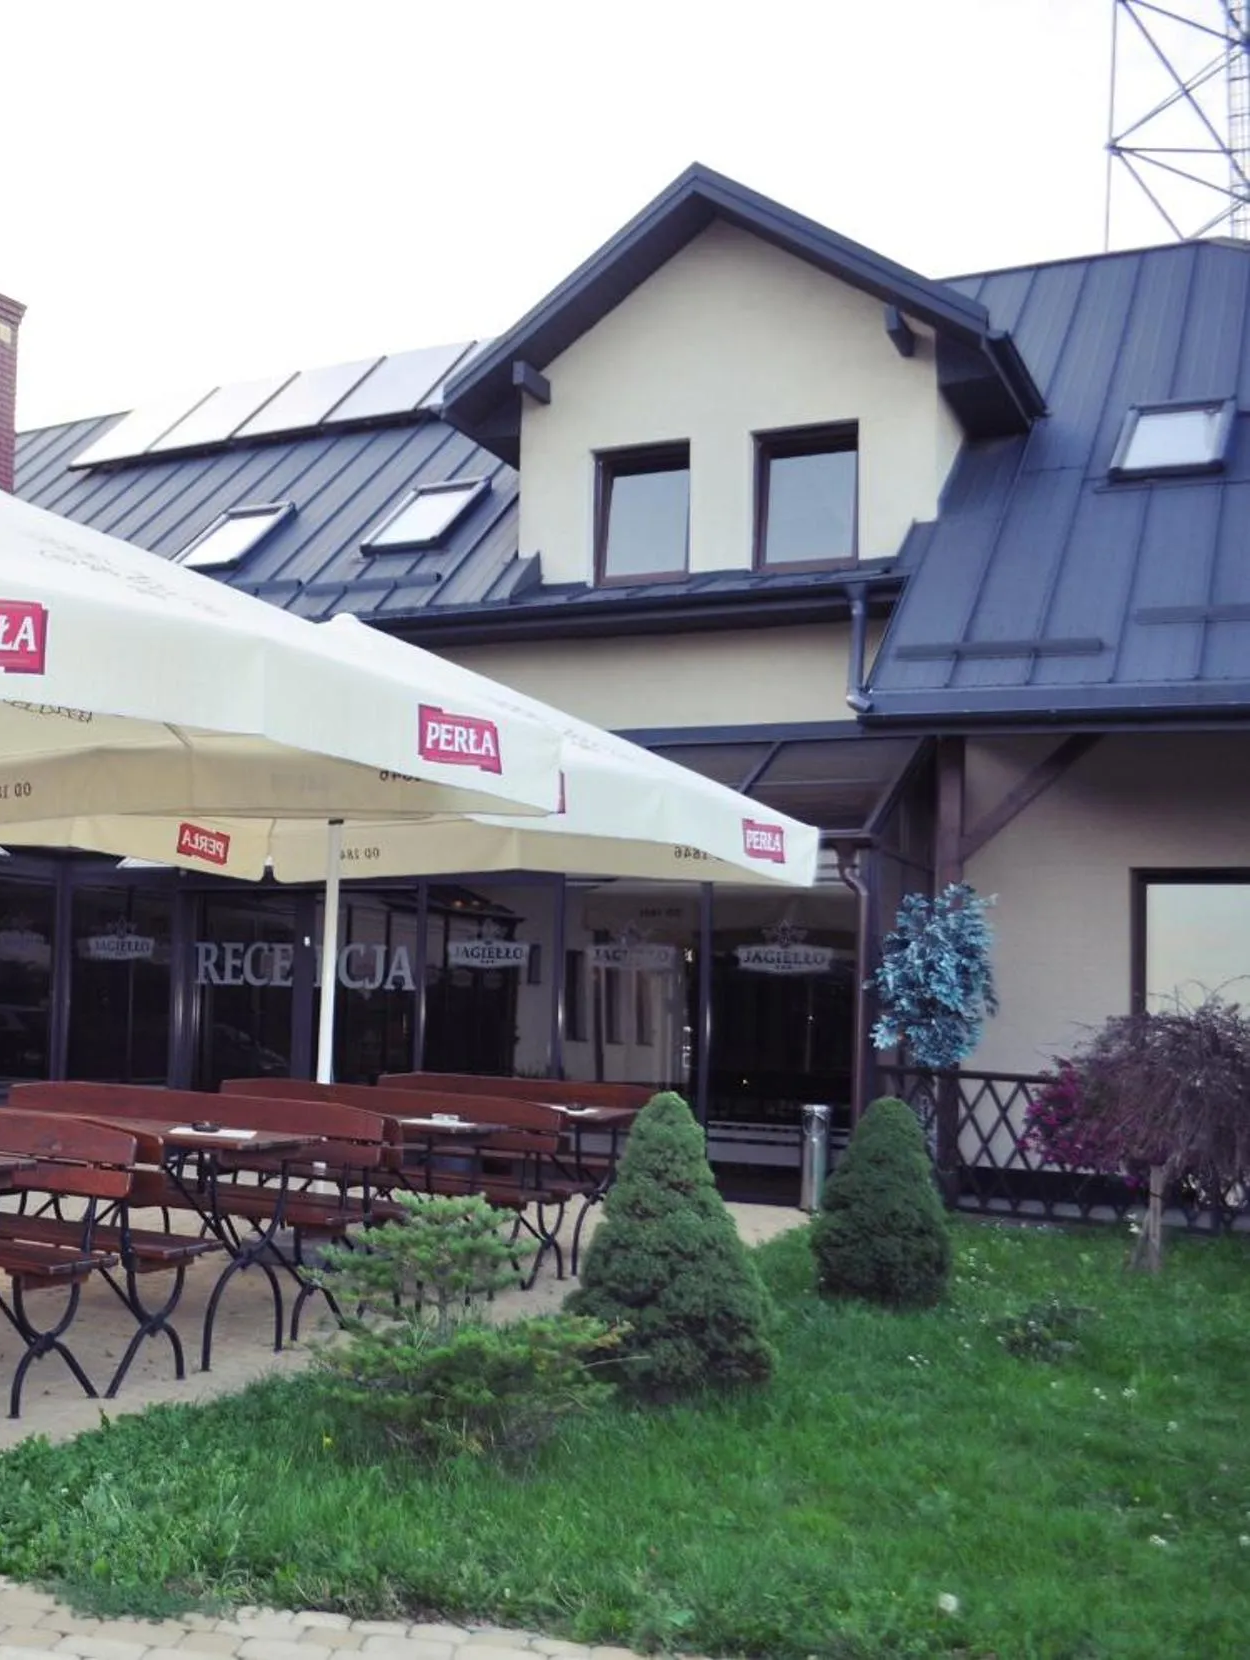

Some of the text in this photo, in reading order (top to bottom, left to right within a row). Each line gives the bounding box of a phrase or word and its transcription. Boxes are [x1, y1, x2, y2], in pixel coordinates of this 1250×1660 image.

[426, 720, 497, 758] PERŁA
[745, 828, 783, 853] PERŁA
[195, 942, 416, 991] RECECJA
